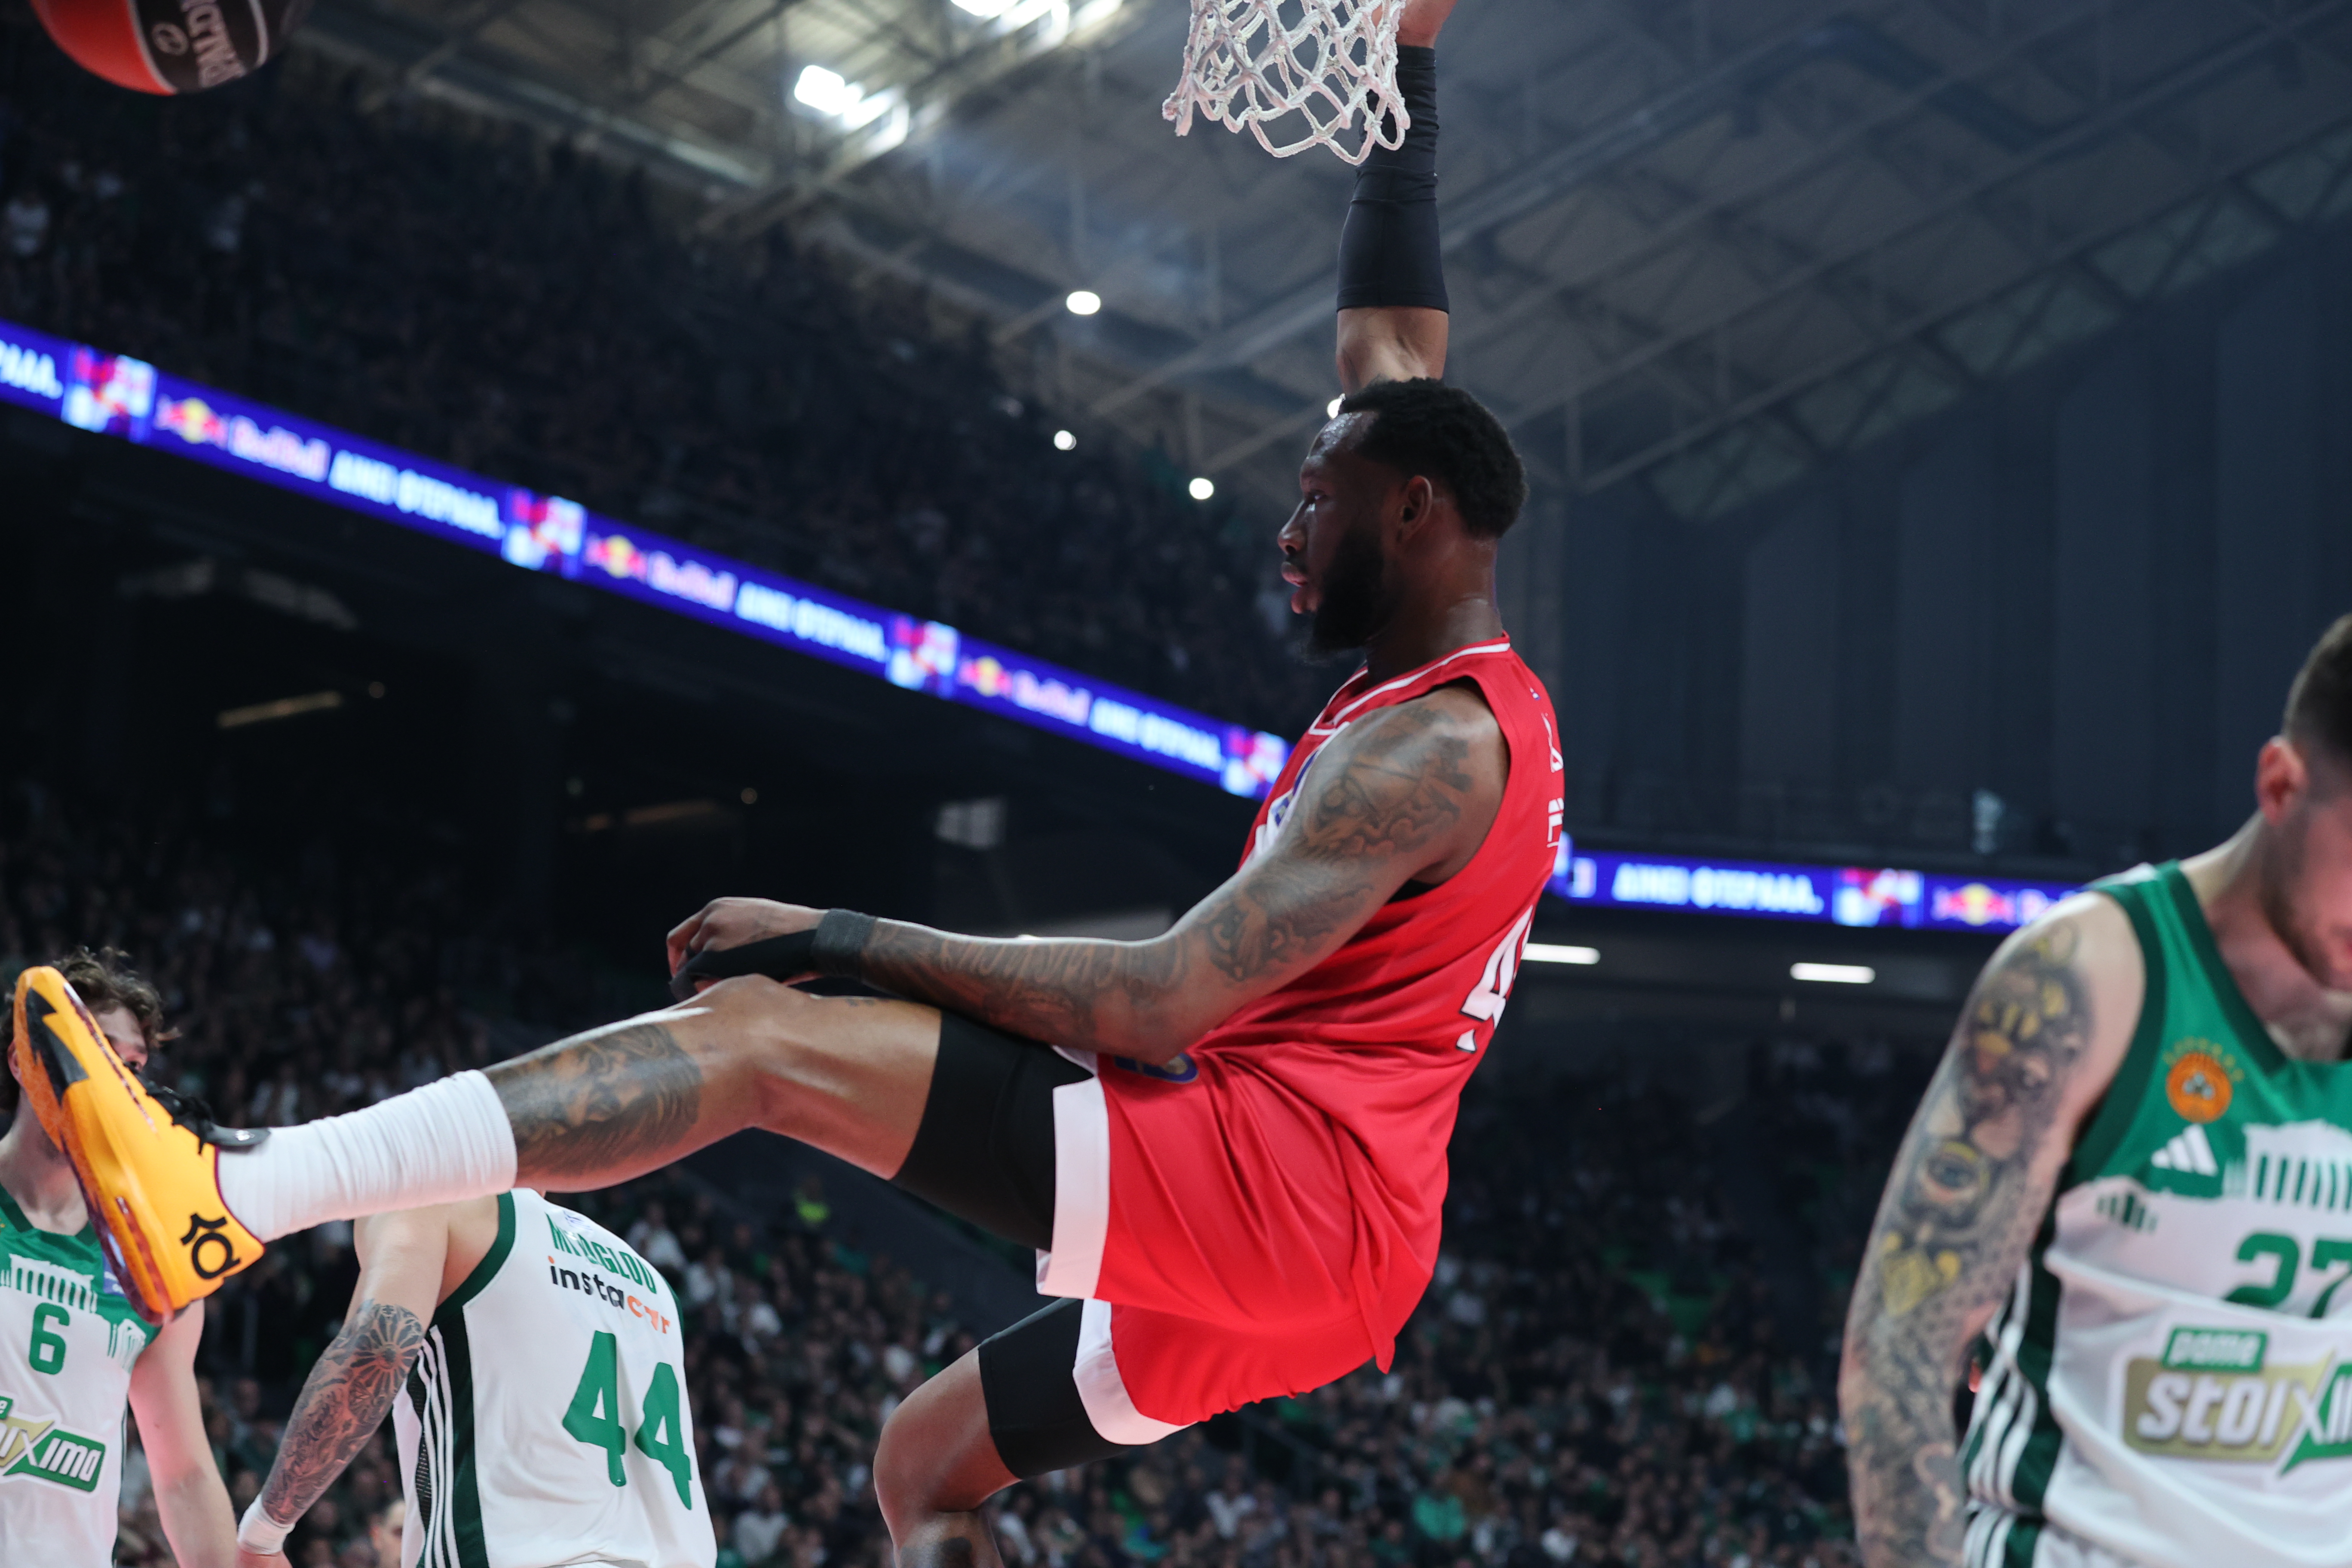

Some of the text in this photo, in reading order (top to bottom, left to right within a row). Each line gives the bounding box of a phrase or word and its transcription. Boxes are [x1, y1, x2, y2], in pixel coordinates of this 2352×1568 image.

[2223, 1232, 2352, 1319] 27
[29, 1302, 70, 1375] 6
[562, 1330, 692, 1511] 44
